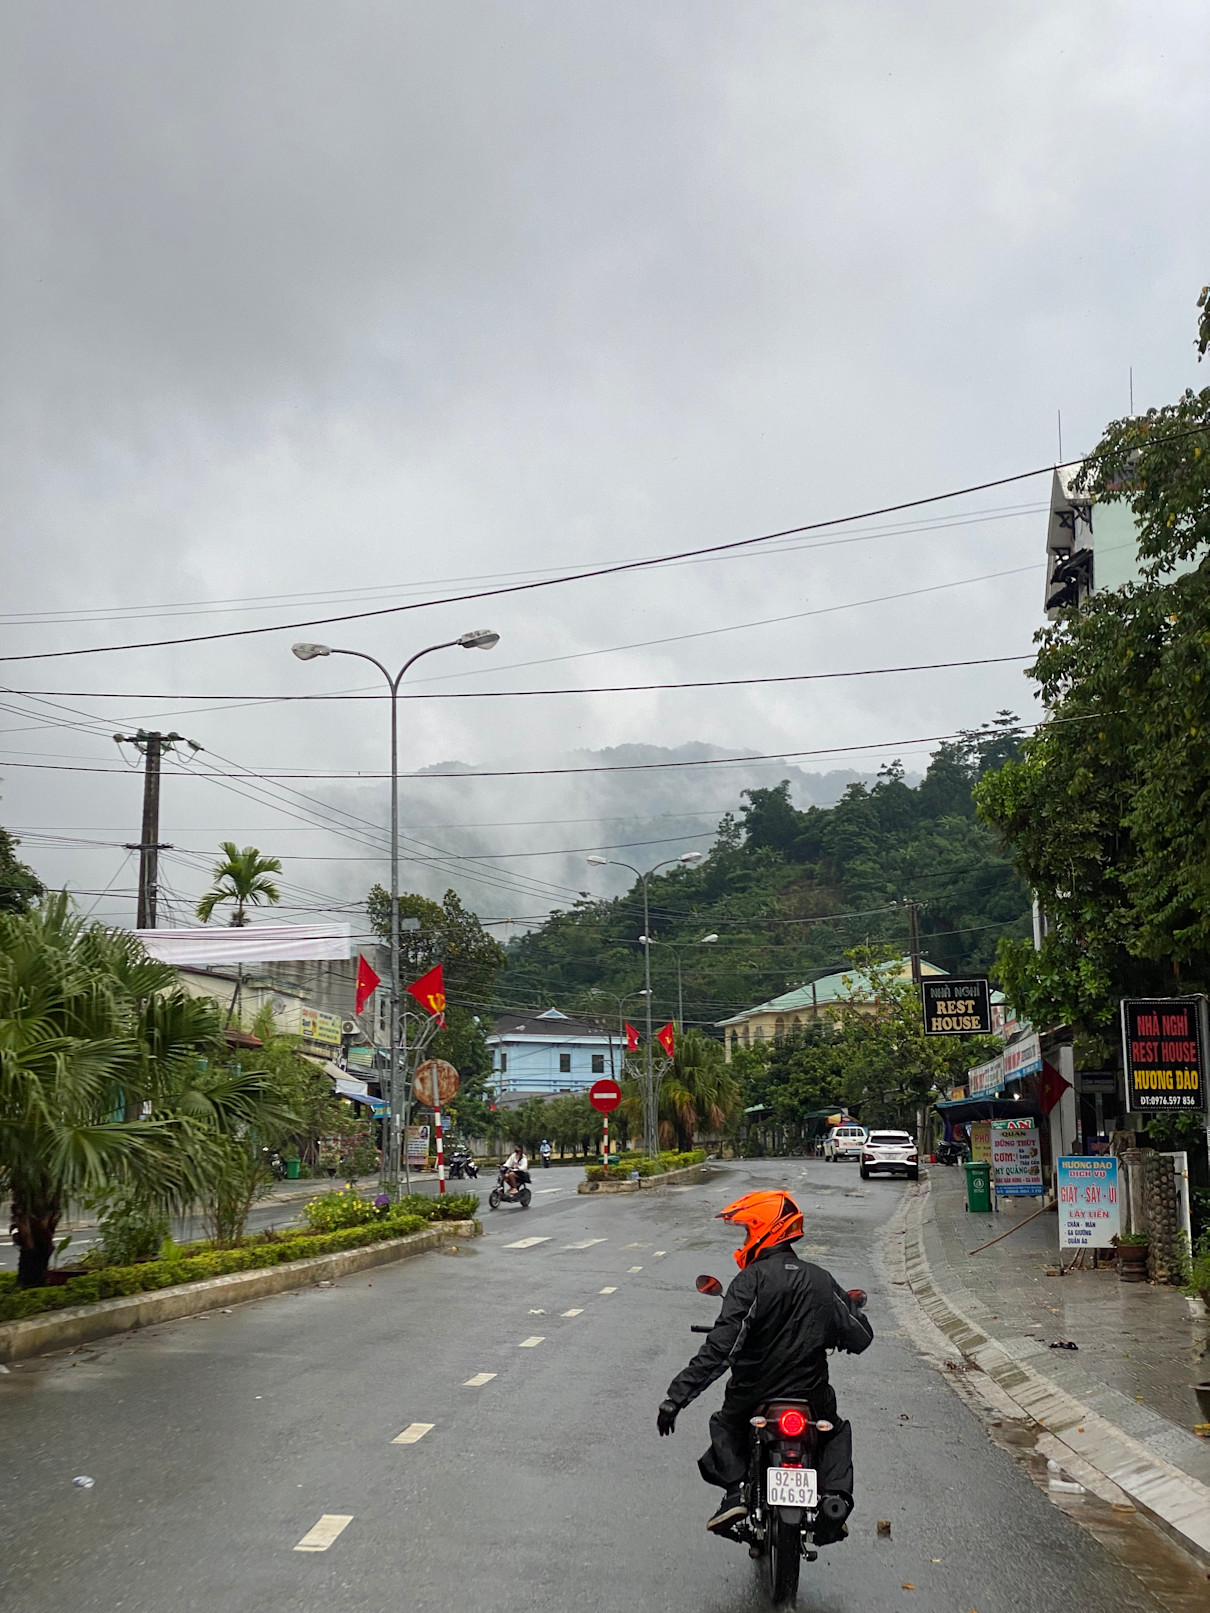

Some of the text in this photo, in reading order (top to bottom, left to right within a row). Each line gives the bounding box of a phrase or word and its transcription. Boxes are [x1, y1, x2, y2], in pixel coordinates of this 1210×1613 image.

[936, 1000, 976, 1015] REST
[931, 1016, 982, 1031] HOUSE
[1137, 1008, 1188, 1036] NHÀ NGHỈ
[1131, 1041, 1197, 1062] REST HOUSE
[1133, 1070, 1174, 1090] HƯƠNG
[1175, 1066, 1199, 1090] ĐÀO
[1062, 1161, 1092, 1169] HƯƠNG
[1069, 1170, 1107, 1178] DỊCH VỤ
[1060, 1183, 1078, 1206] GIẬT
[775, 1471, 809, 1487] 92-BA
[771, 1488, 814, 1504] 046.97
